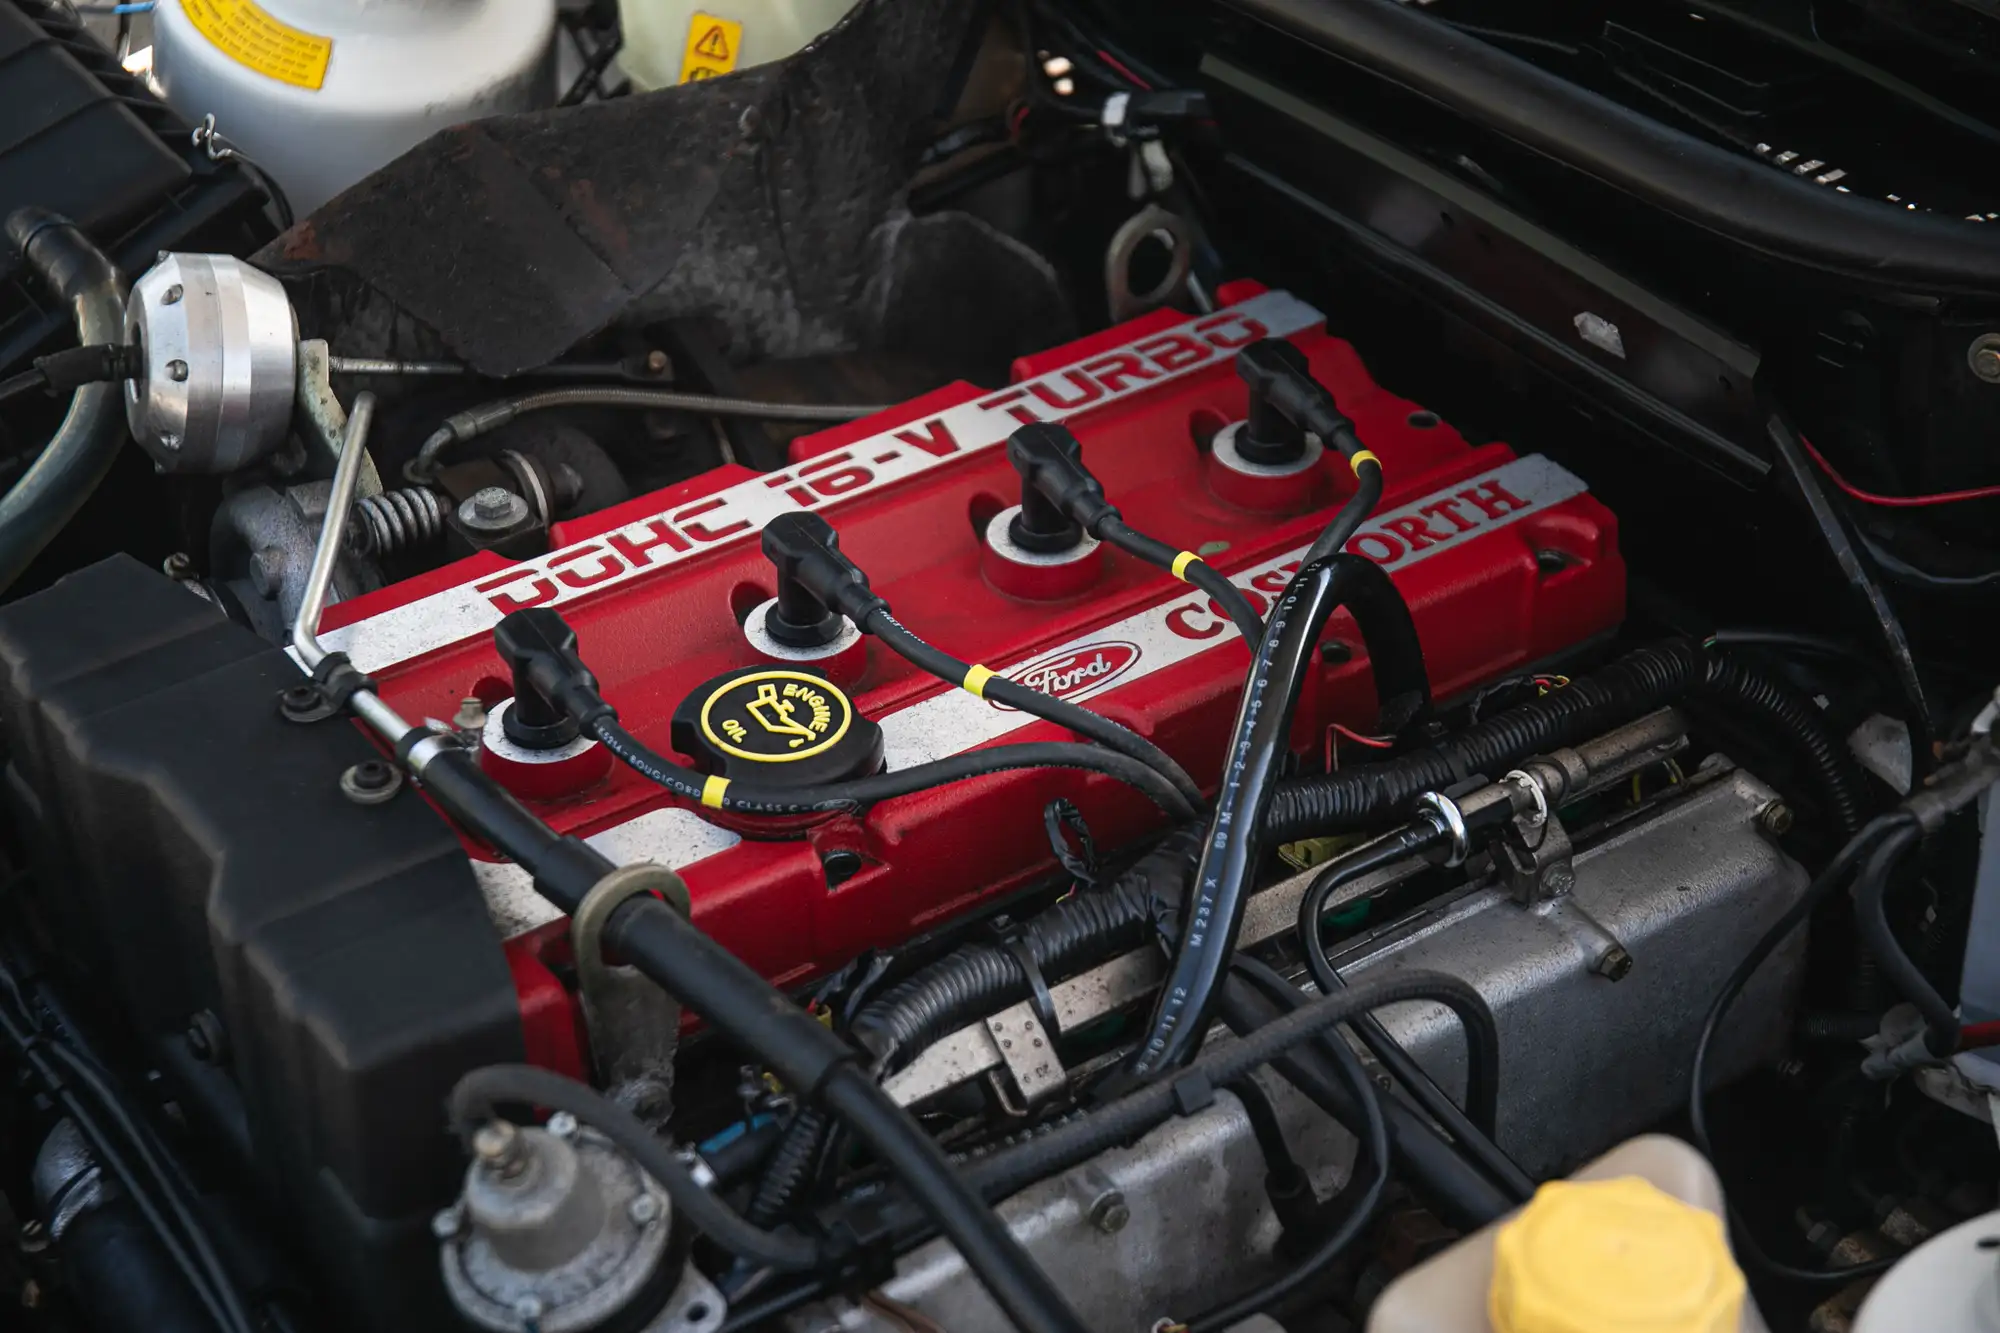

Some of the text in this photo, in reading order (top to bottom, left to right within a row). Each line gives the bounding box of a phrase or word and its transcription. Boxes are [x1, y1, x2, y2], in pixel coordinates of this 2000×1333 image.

[474, 498, 753, 616] DOHC
[977, 312, 1268, 425] TURBO
[1023, 480, 1532, 694] Ford COSORTH
[722, 683, 831, 743] ENGINE OIL
[736, 800, 782, 812] CLASS
[789, 804, 798, 812] C
[1149, 1038, 1165, 1056] 10
[1161, 1014, 1176, 1031] 11
[1172, 986, 1187, 1005] 12
[1189, 933, 1203, 947] M
[1220, 811, 1232, 825] M
